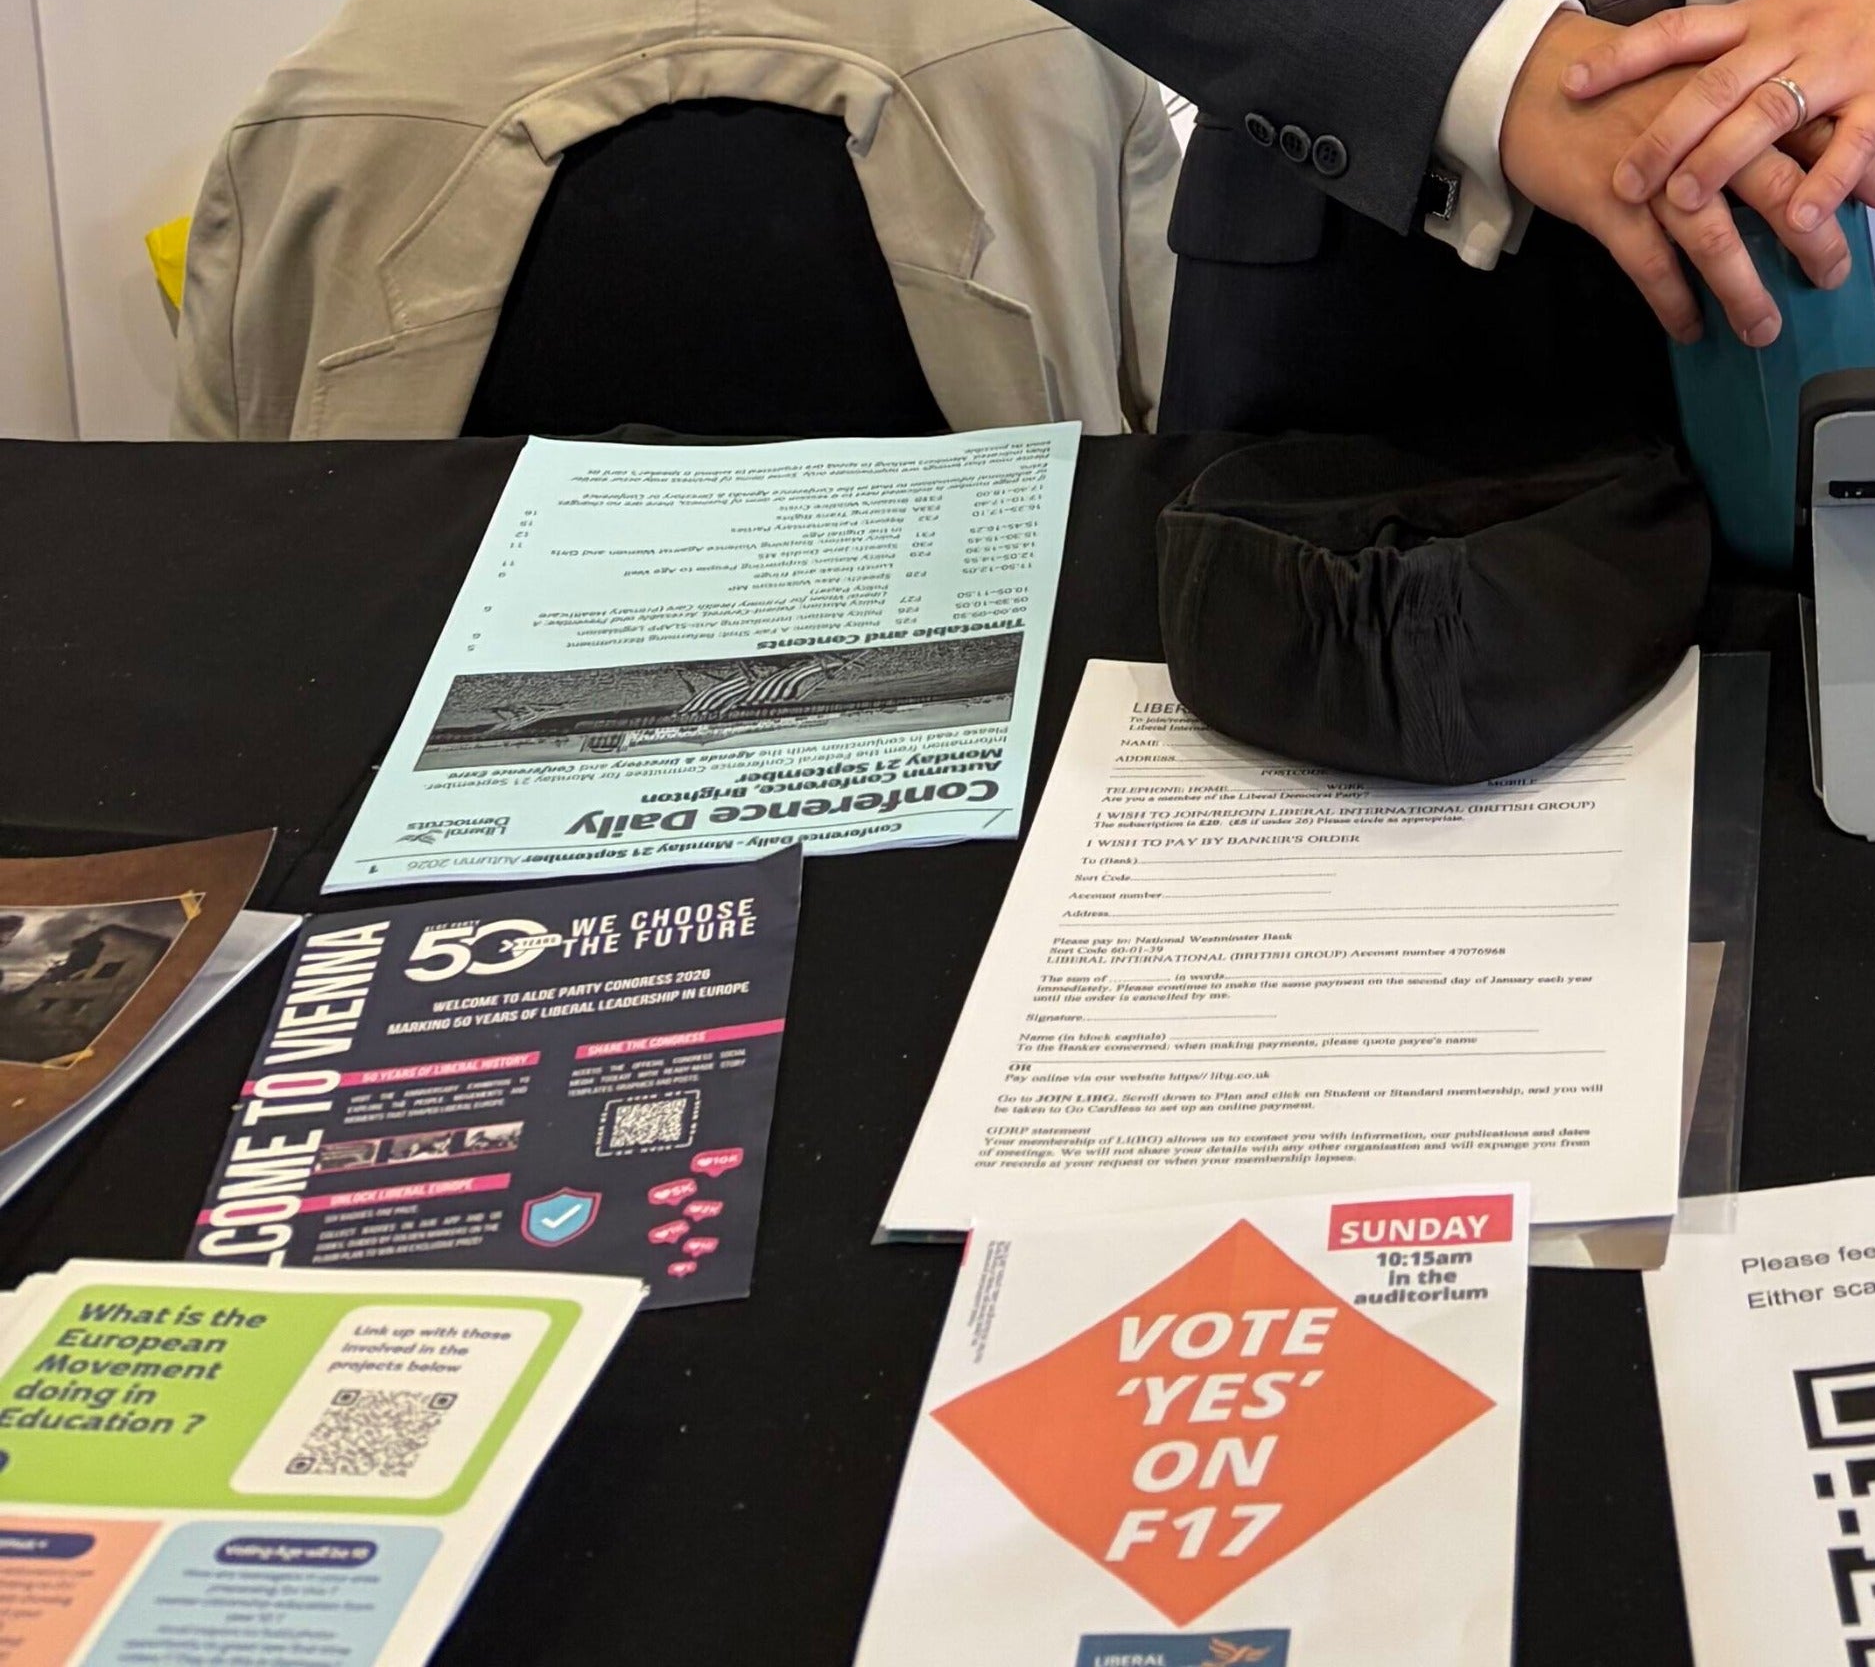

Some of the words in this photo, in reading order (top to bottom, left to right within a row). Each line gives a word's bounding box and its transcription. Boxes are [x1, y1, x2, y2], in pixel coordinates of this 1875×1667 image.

[875, 759, 902, 773] 21
[902, 760, 1002, 779] Autumn
[906, 747, 1003, 768] Monday
[734, 761, 870, 785] September
[754, 772, 897, 793] Conference,
[641, 786, 748, 805] Brighton
[709, 779, 999, 825] Conference
[564, 808, 698, 839] Daily
[1098, 839, 1137, 847] WISH
[1143, 839, 1162, 847] TO
[1165, 838, 1198, 847] PAY
[1201, 837, 1224, 845] BY
[1227, 835, 1303, 845] BANKER'S
[1307, 835, 1359, 843] ORDER
[572, 915, 617, 936] WE
[631, 898, 755, 931] CHOOSE
[561, 935, 621, 959] THE
[635, 917, 757, 950] FUTURE
[265, 920, 391, 1064] VIENNA
[433, 995, 499, 1012] WELCOME
[503, 993, 519, 1004] TO
[521, 988, 556, 1002] ALDE
[558, 983, 602, 998] PARTY
[604, 973, 673, 992] CONGRESS
[676, 969, 710, 983] 2026
[387, 1018, 451, 1034] MARKING
[453, 1016, 472, 1028] 50
[475, 1010, 518, 1025] YEARS
[521, 1008, 538, 1020] OF
[540, 1002, 595, 1018] LIBERAL
[598, 990, 680, 1011] LEADERSHIP
[682, 988, 696, 999] IN
[698, 981, 749, 998] EUROPE
[254, 1069, 342, 1123] TO
[199, 1136, 319, 1268] COME
[1339, 1214, 1489, 1245] SUNDAY
[1376, 1249, 1472, 1268] 10:15am
[1741, 1253, 1830, 1274] Please
[1388, 1269, 1411, 1286] in
[1417, 1268, 1457, 1285] the
[1354, 1285, 1488, 1305] auditorium
[1748, 1288, 1823, 1309] Either
[79, 1303, 170, 1324] What
[174, 1305, 204, 1326] is
[210, 1308, 267, 1328] the
[56, 1329, 226, 1354] European
[1117, 1307, 1338, 1363] VOTE
[34, 1355, 222, 1380] Movement
[13, 1380, 117, 1407] doing
[124, 1385, 156, 1405] in
[0, 1407, 173, 1434] Education
[186, 1414, 206, 1435] ?
[1131, 1436, 1278, 1493] ON
[1104, 1503, 1282, 1562] F17
